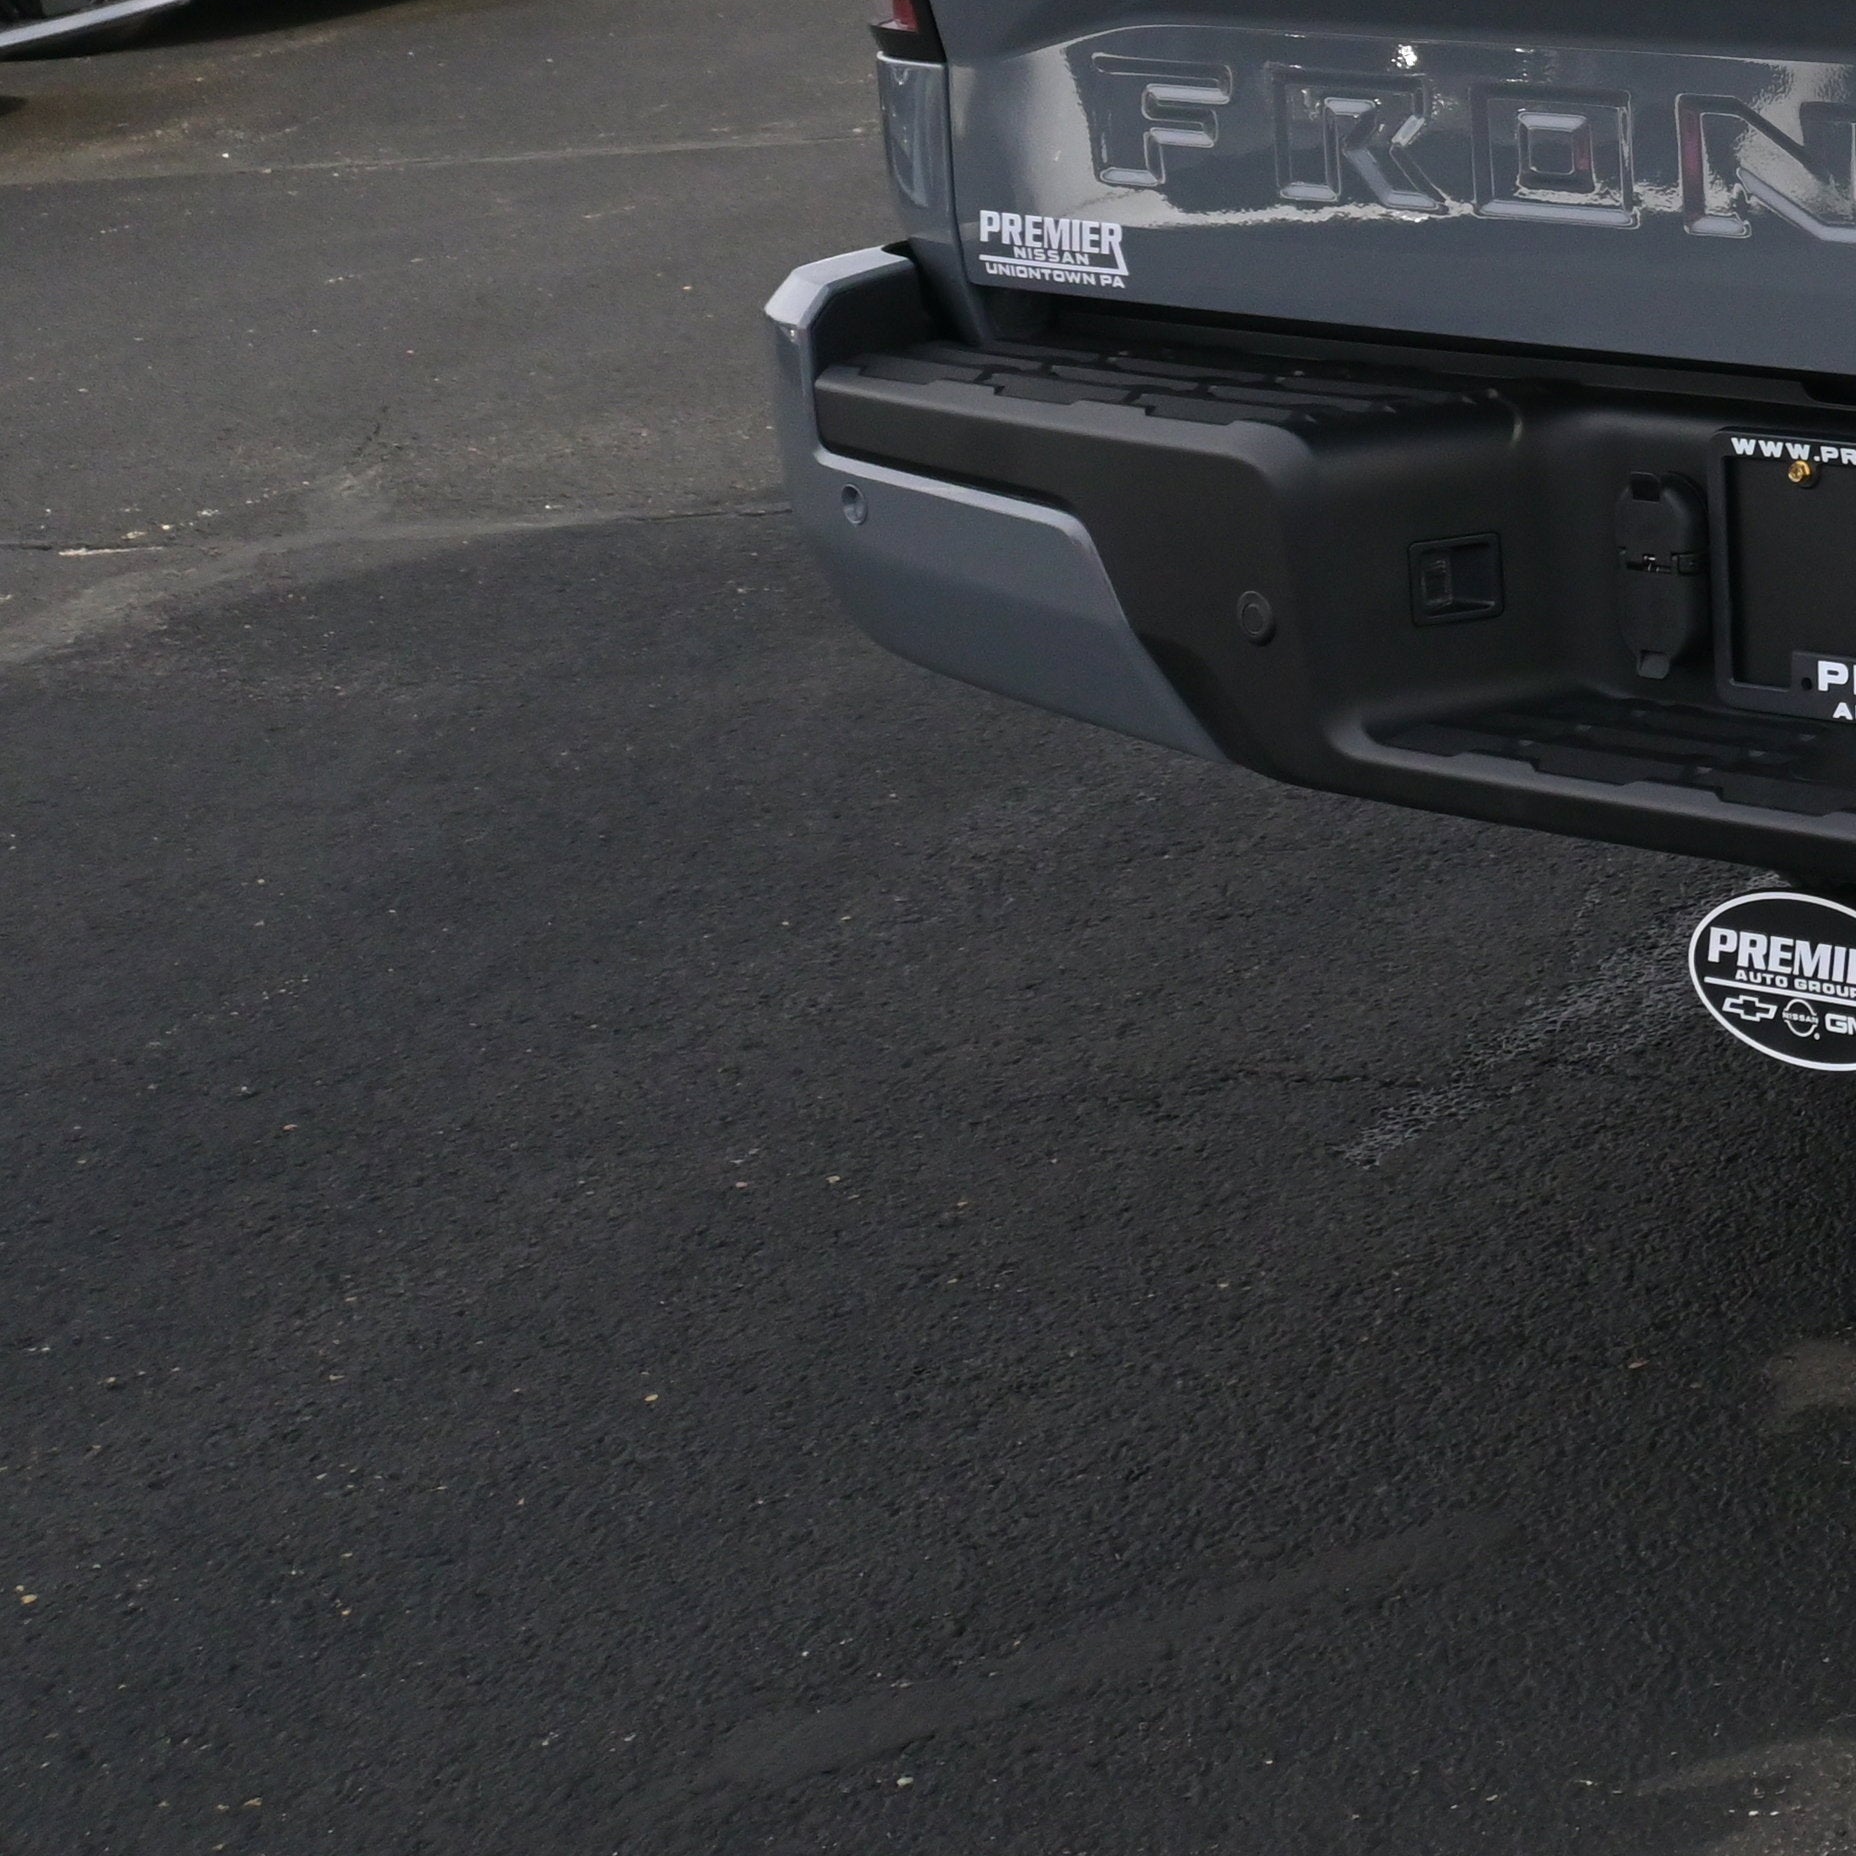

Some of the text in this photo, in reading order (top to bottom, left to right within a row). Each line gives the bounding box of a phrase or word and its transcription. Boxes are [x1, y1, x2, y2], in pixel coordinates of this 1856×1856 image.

[979, 209, 1124, 256] PREMIER
[1013, 246, 1090, 266] NISSAN
[985, 262, 1126, 289] UNIONTOWN PA
[1734, 968, 1788, 988] AUTO
[1782, 1010, 1820, 1025] NISSAN
